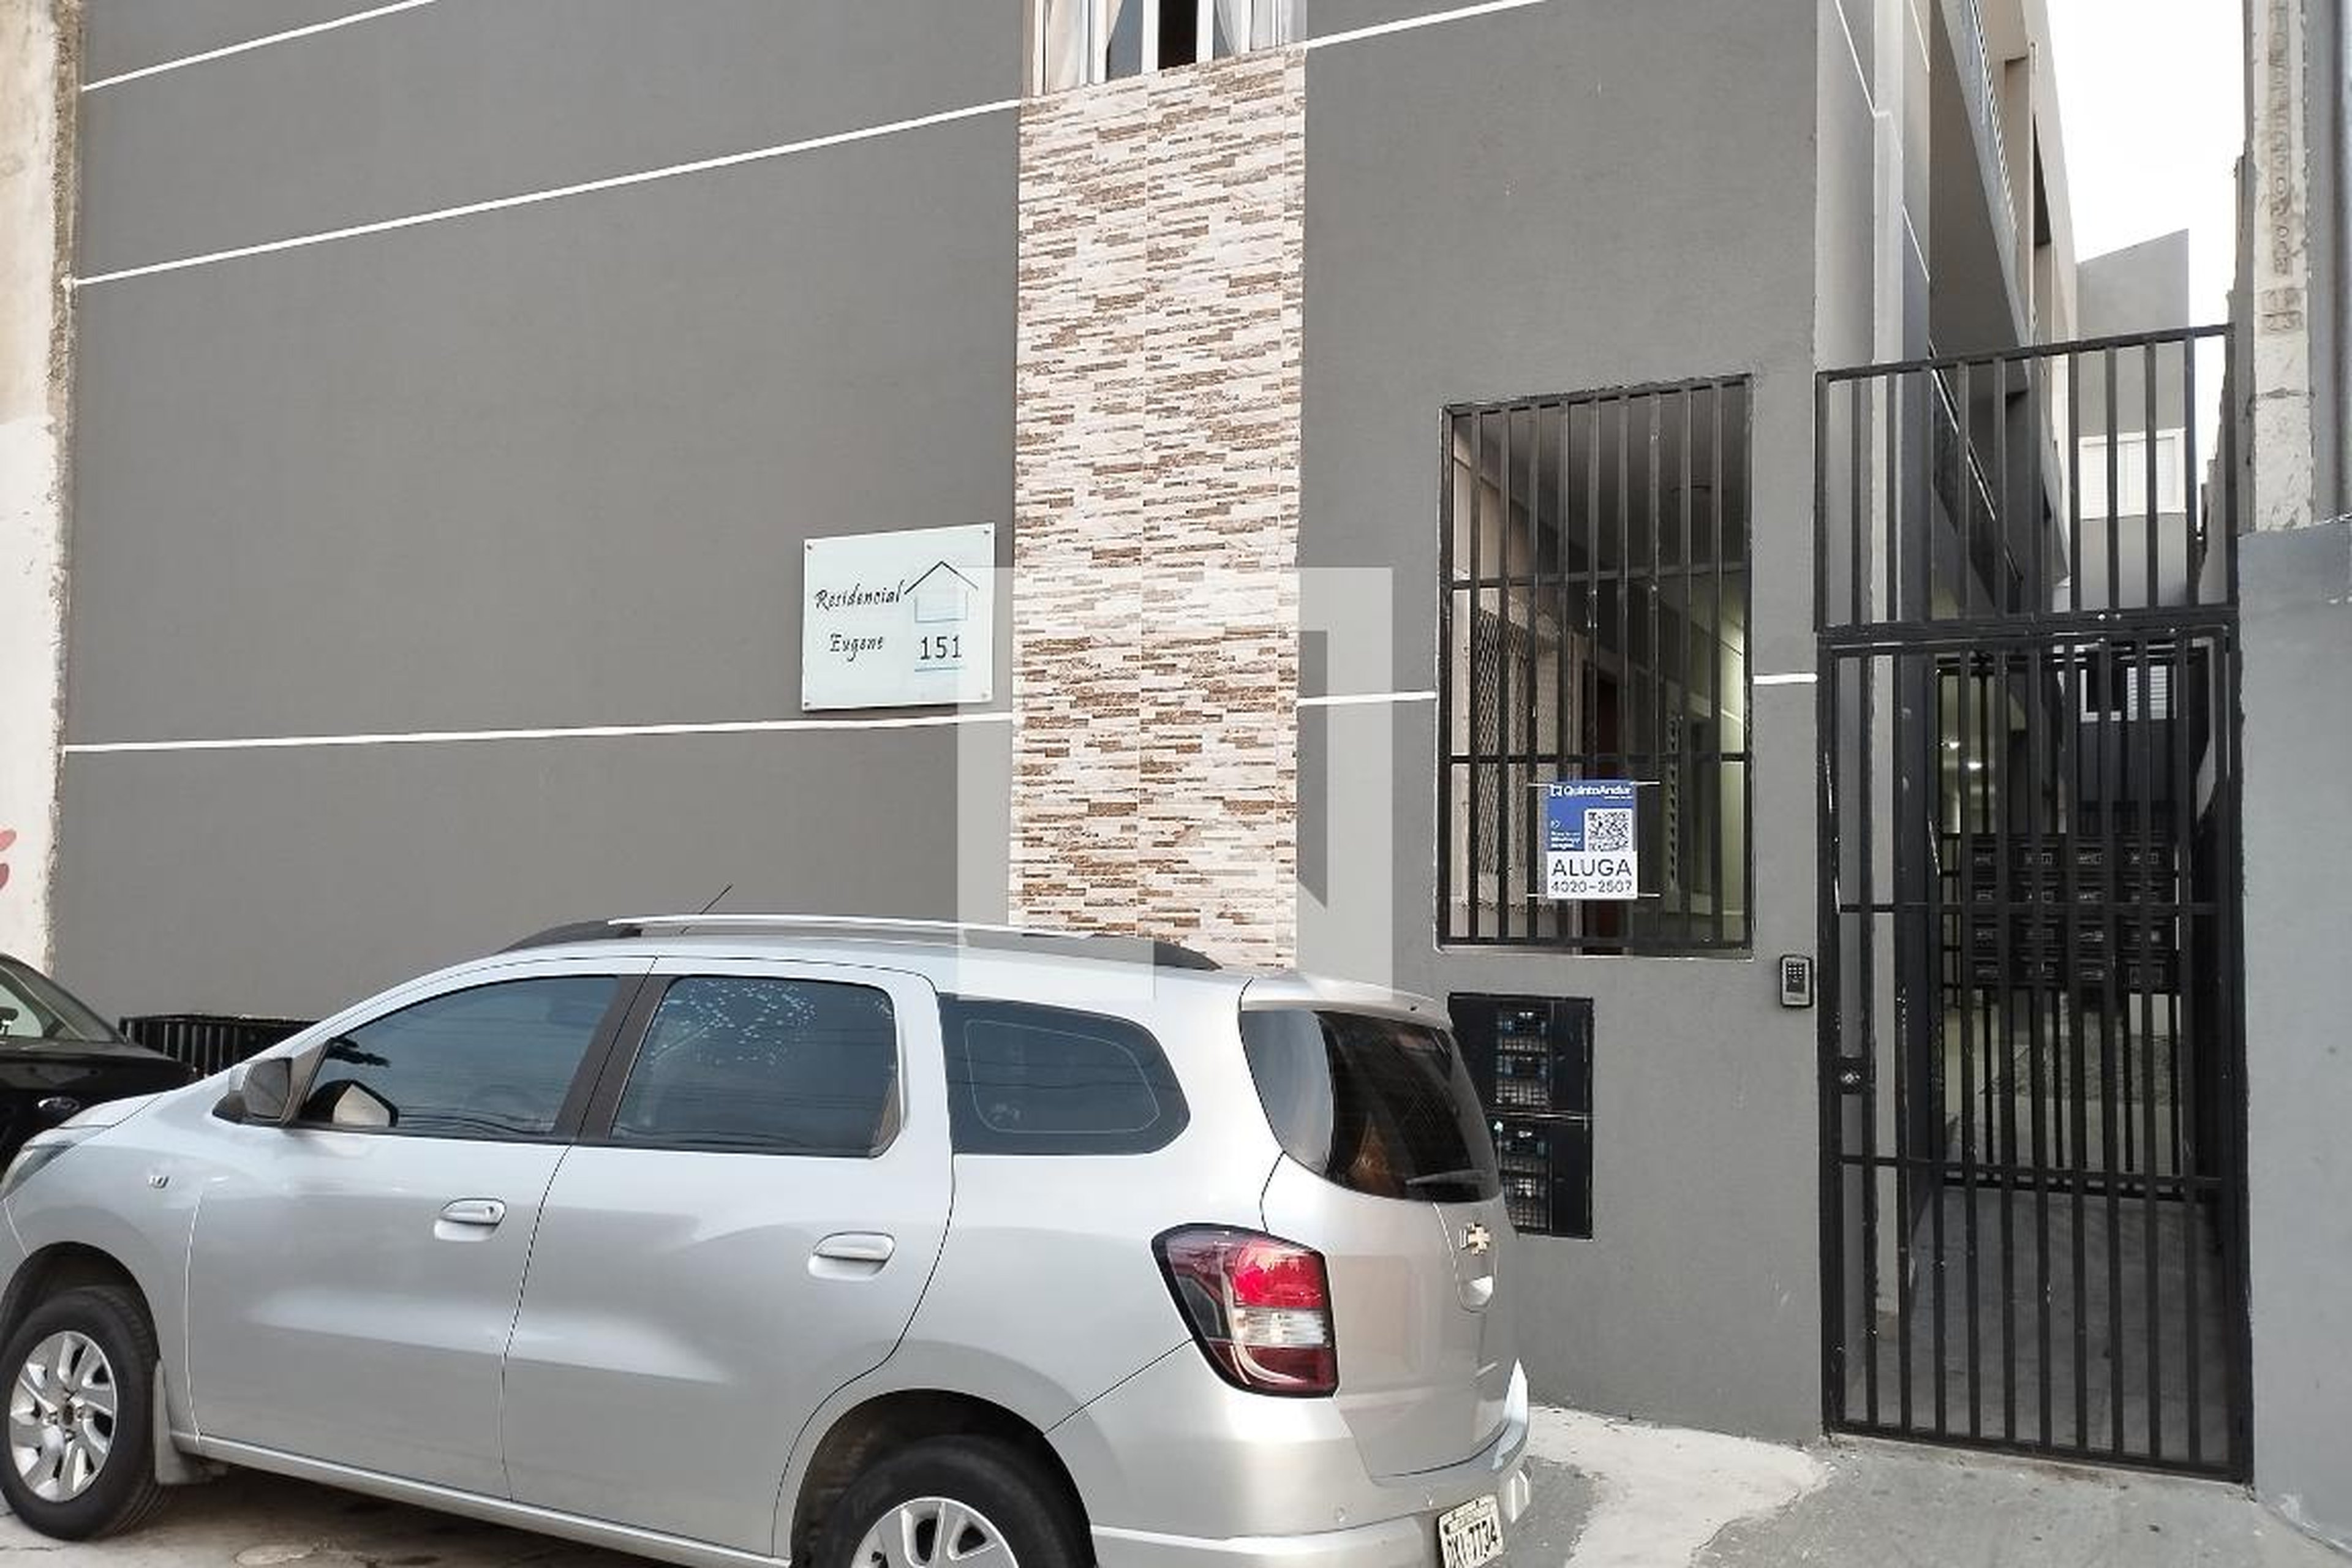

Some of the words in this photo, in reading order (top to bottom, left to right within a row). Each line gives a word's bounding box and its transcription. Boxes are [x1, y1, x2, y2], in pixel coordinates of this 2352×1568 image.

[815, 579, 905, 611] Residencial
[920, 635, 962, 660] 151
[1551, 859, 1632, 876] ALUGA
[1550, 879, 1632, 893] 4020-2507
